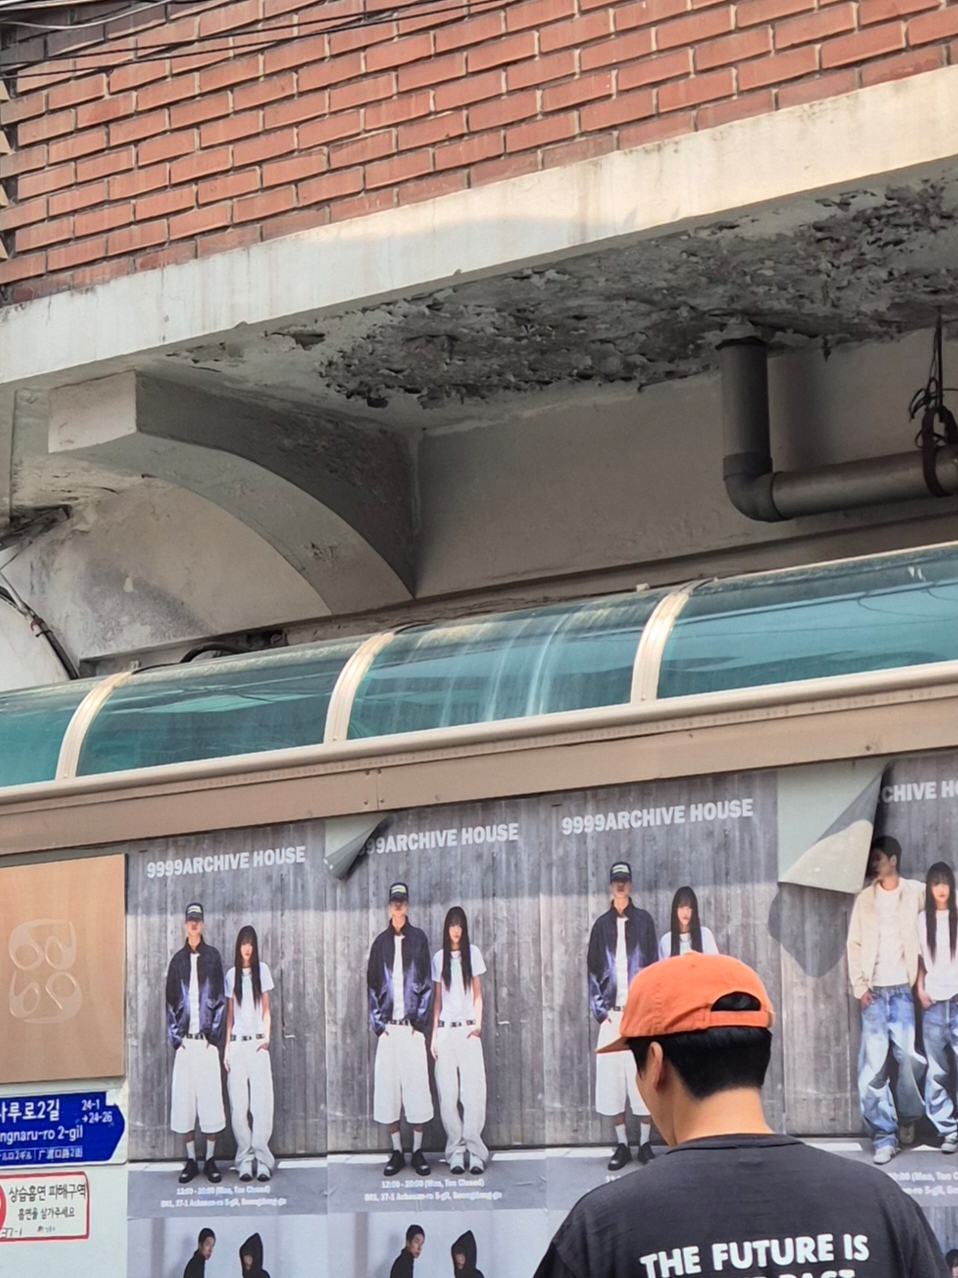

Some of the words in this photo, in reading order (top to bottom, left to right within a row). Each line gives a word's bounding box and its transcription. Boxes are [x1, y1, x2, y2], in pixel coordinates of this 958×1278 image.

[562, 804, 685, 835] 9999ARCHIVE
[690, 799, 754, 822] HOUSE
[360, 829, 458, 855] 99ARCHIVE
[461, 823, 519, 845] HOUSE
[147, 852, 250, 878] 9999ARCHIVE
[253, 846, 306, 868] HOUSE
[82, 1099, 100, 1111] 24-1
[57, 1124, 83, 1142] 2-gil
[711, 1233, 835, 1271] FUTURE
[843, 1233, 870, 1262] IS
